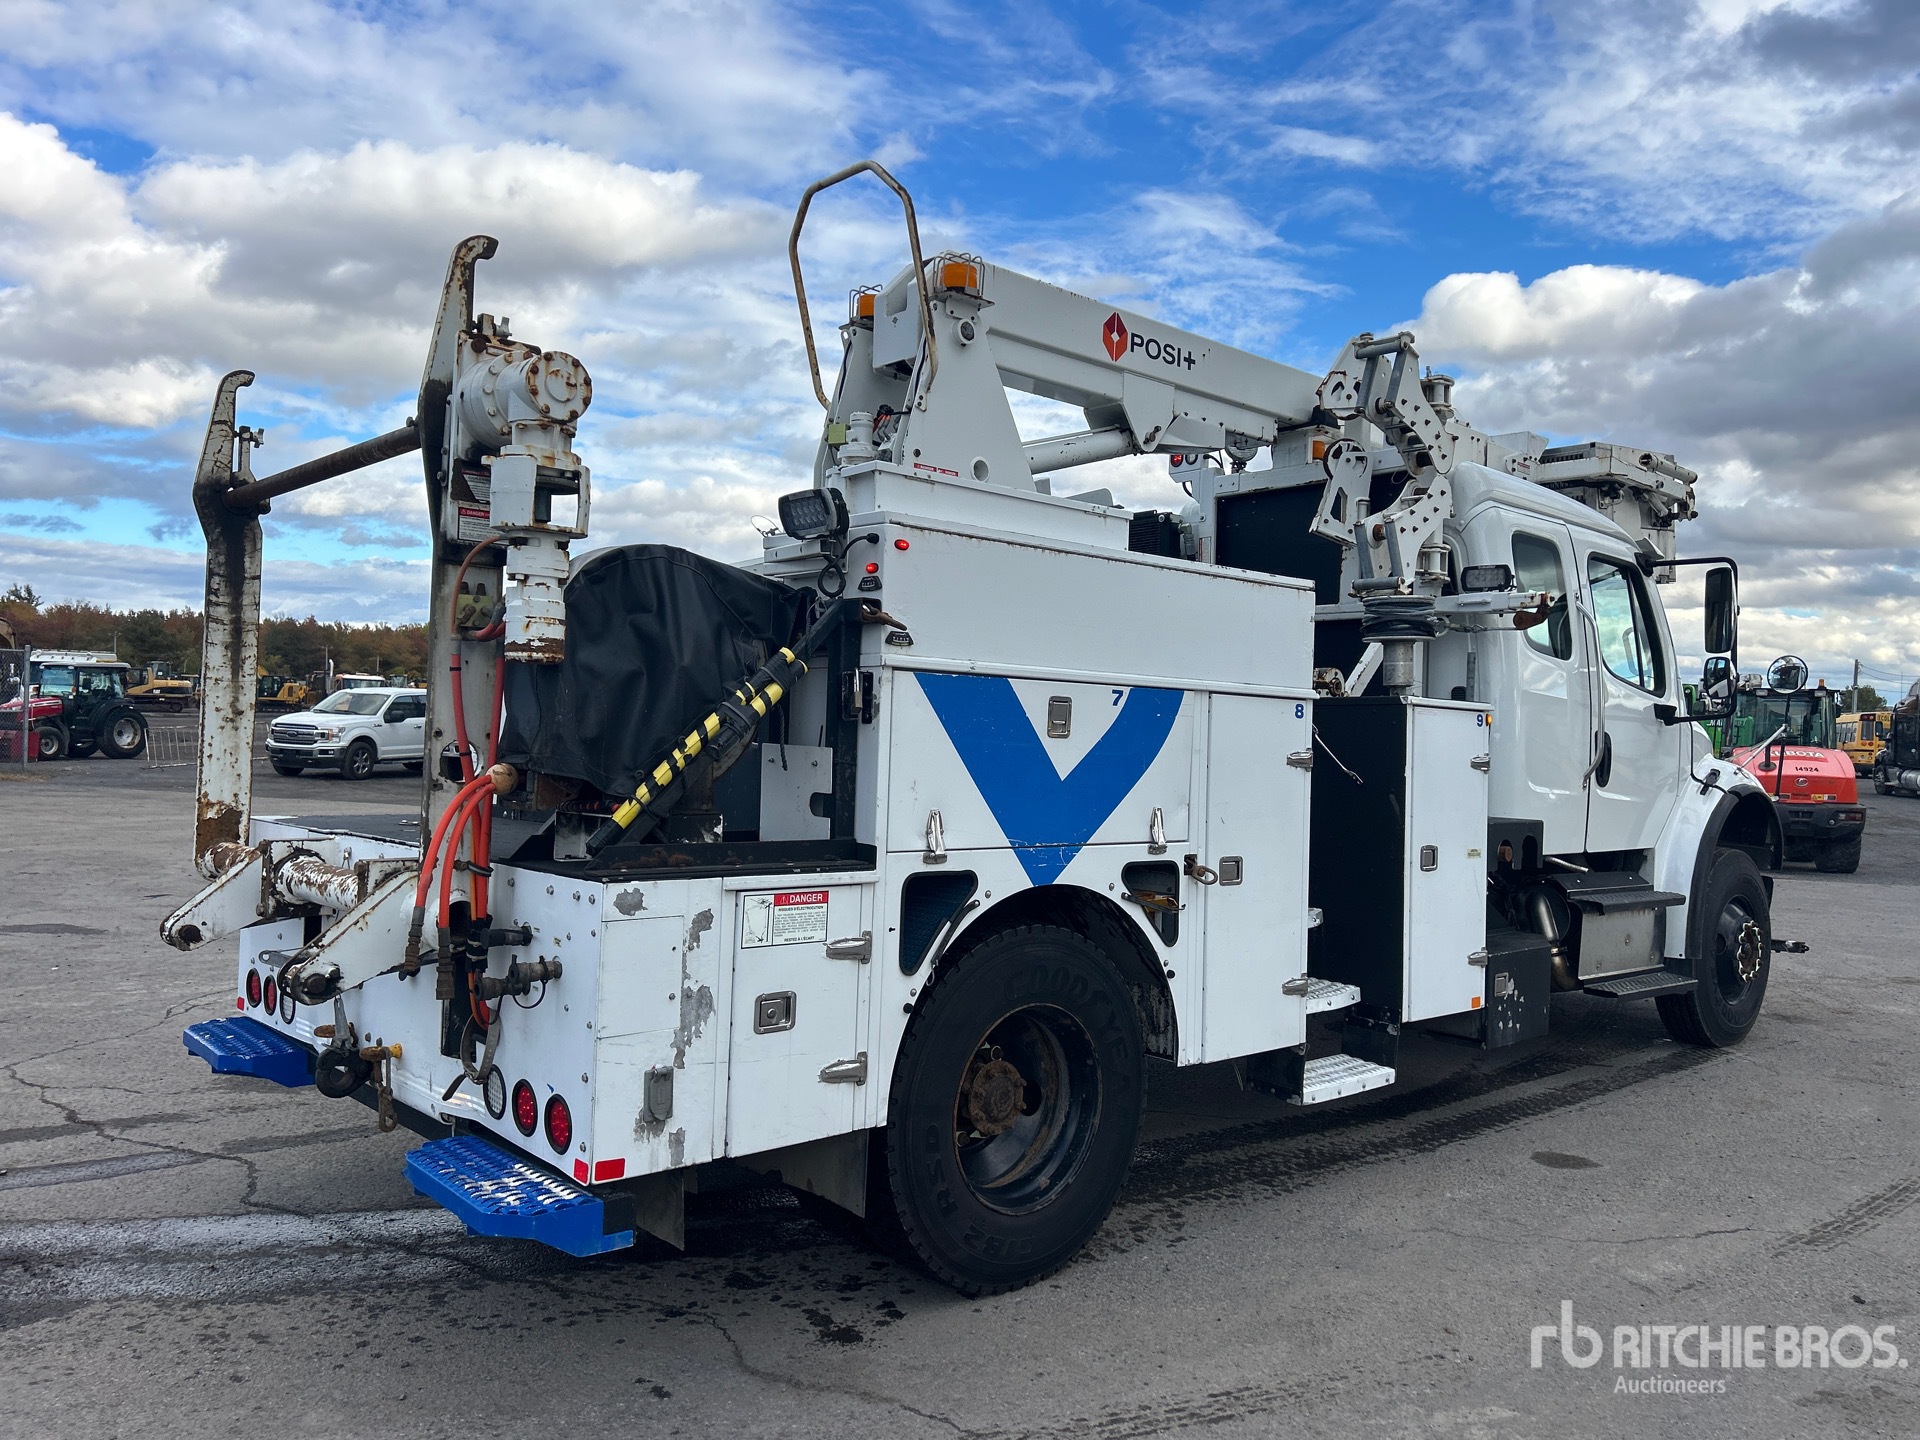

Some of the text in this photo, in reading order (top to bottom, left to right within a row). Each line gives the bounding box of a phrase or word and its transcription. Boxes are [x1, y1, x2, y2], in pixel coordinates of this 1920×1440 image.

[1130, 332, 1196, 370] POSI+
[1111, 689, 1123, 706] 7
[1294, 703, 1305, 719] 8
[1476, 713, 1484, 728] 9
[790, 894, 822, 903] DANGER
